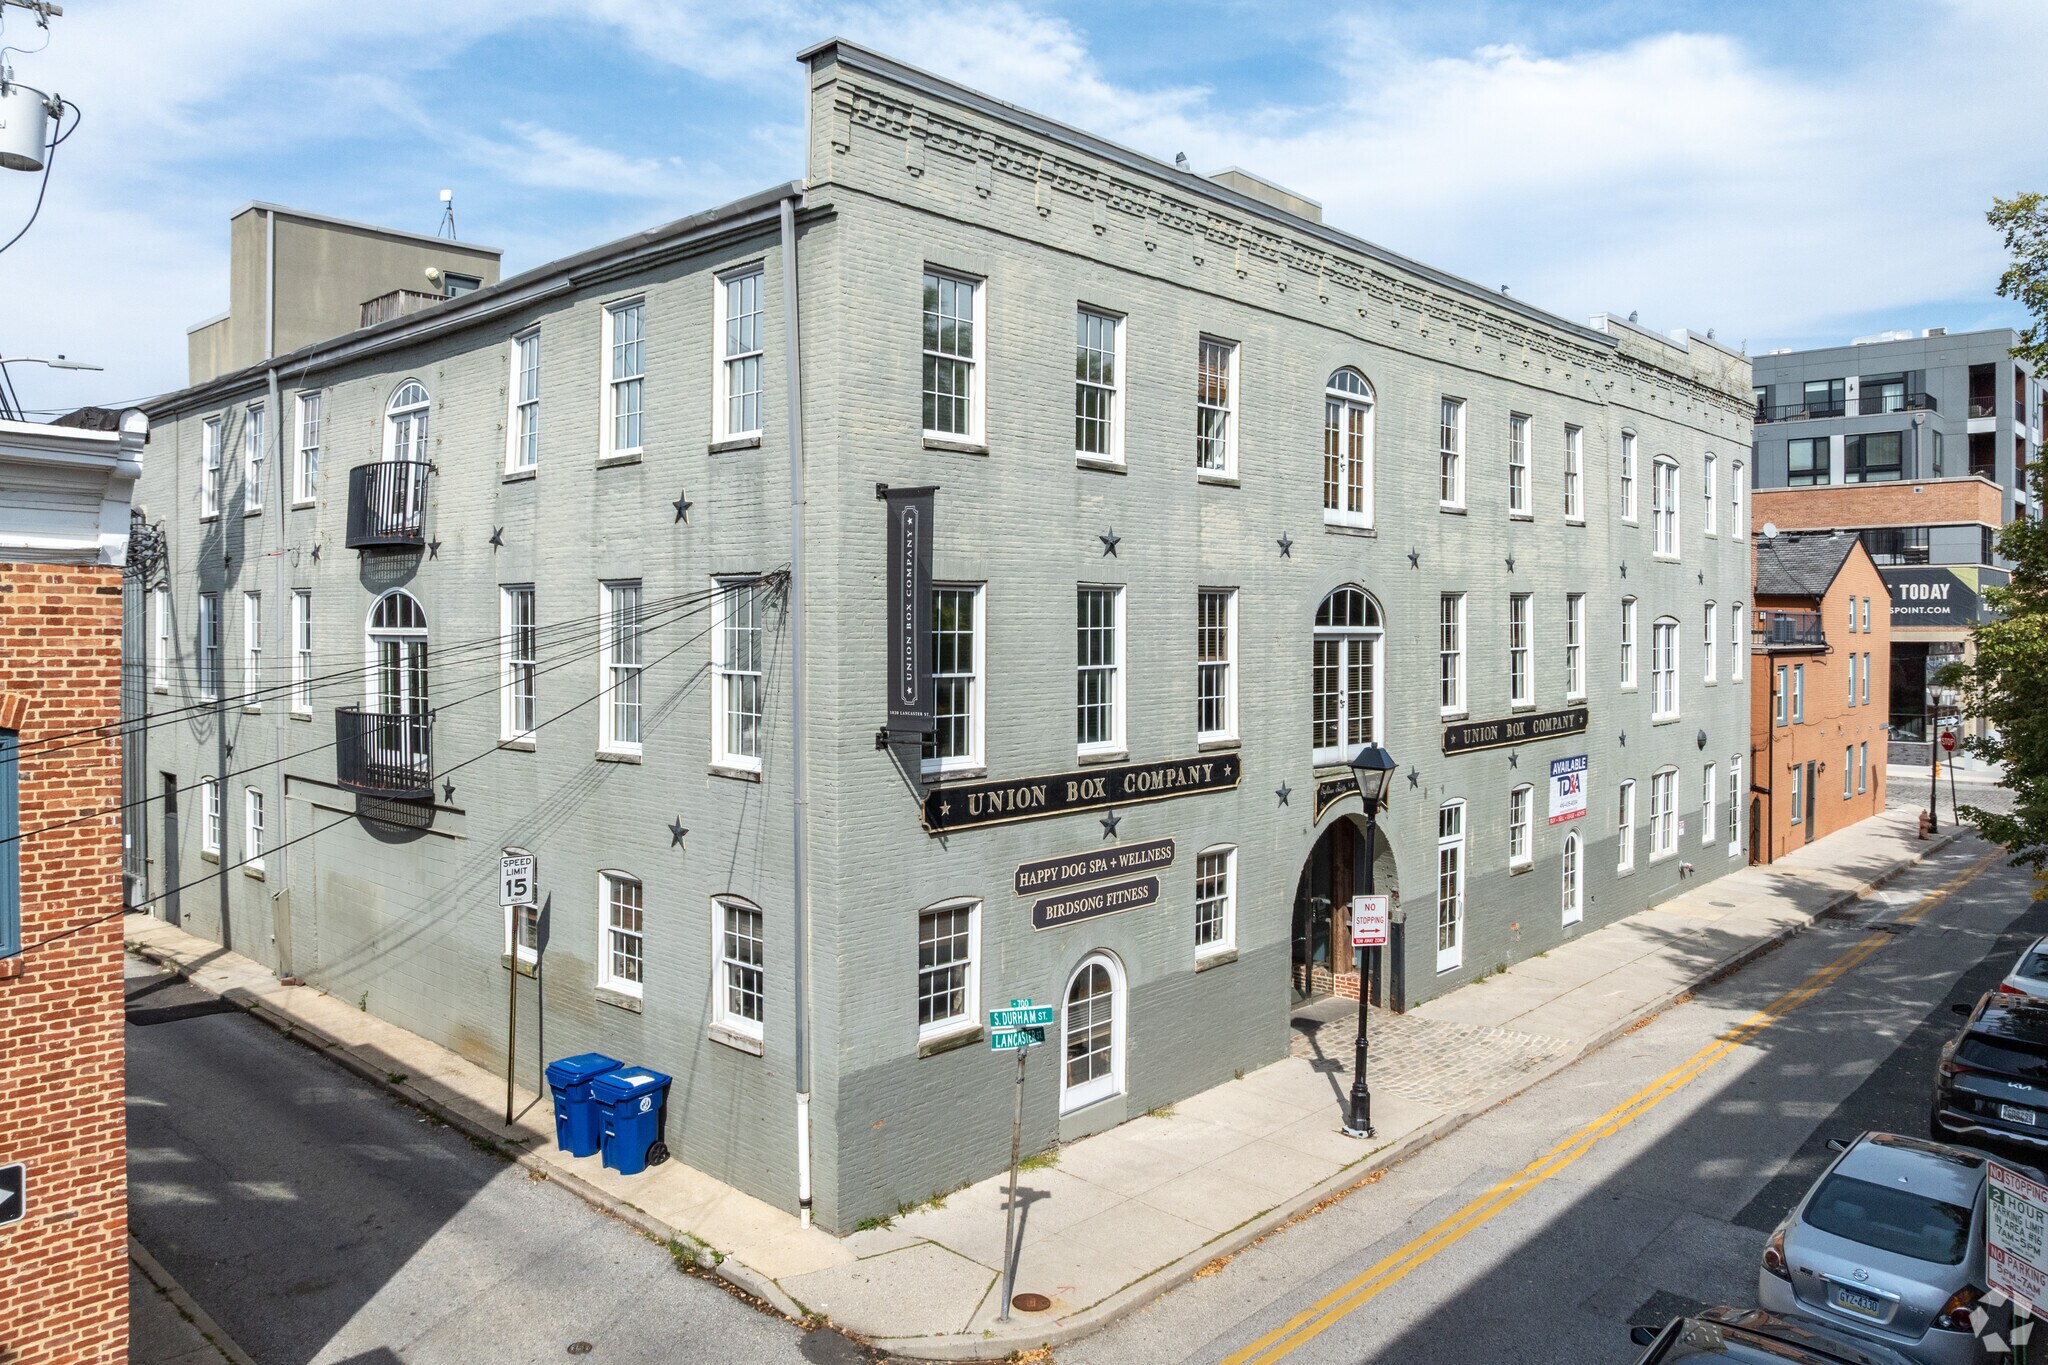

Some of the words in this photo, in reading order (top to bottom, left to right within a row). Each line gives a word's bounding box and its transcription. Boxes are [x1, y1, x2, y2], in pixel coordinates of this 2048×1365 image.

[1900, 583, 1950, 600] TODAY
[1463, 726, 1498, 744] UNION
[1506, 722, 1526, 738] BOX
[1533, 714, 1575, 734] COMPANY
[1942, 737, 1954, 745] STOP
[1553, 757, 1586, 775] AVAILABLE
[968, 785, 1047, 816] UNION
[1066, 777, 1106, 802] BOX
[1124, 763, 1213, 793] COMPANY
[503, 858, 531, 867] SPEED
[506, 867, 528, 876] LIMIT
[1019, 866, 1059, 887] HAPPY
[1061, 862, 1087, 879] DOG
[1089, 858, 1108, 873] SPA
[1119, 846, 1172, 868] WELLNESS
[506, 878, 527, 897] 15
[1046, 896, 1103, 920] BIRDSONG
[1106, 885, 1149, 906] FITNESS
[1364, 903, 1376, 911] NO
[1356, 916, 1384, 925] STOPPING
[1017, 999, 1029, 1007] 700
[994, 1013, 1001, 1026] S.
[1002, 1010, 1037, 1025] DURHAM
[1038, 1011, 1048, 1021] ST.
[995, 1031, 1036, 1048] LANCASTER
[1990, 1165, 2003, 1180] NO
[2005, 1173, 2048, 1203] STOPPING
[1993, 1188, 2001, 1202] 2
[2009, 1197, 2044, 1224] HOUR
[1993, 1202, 2023, 1225] PARKING
[2025, 1219, 2044, 1236] LIMIT
[1995, 1213, 2002, 1225] IN
[2004, 1219, 2026, 1238] AREA
[2028, 1231, 2042, 1246] #16
[1990, 1246, 2003, 1262] NO
[2007, 1256, 2046, 1287] PARKING
